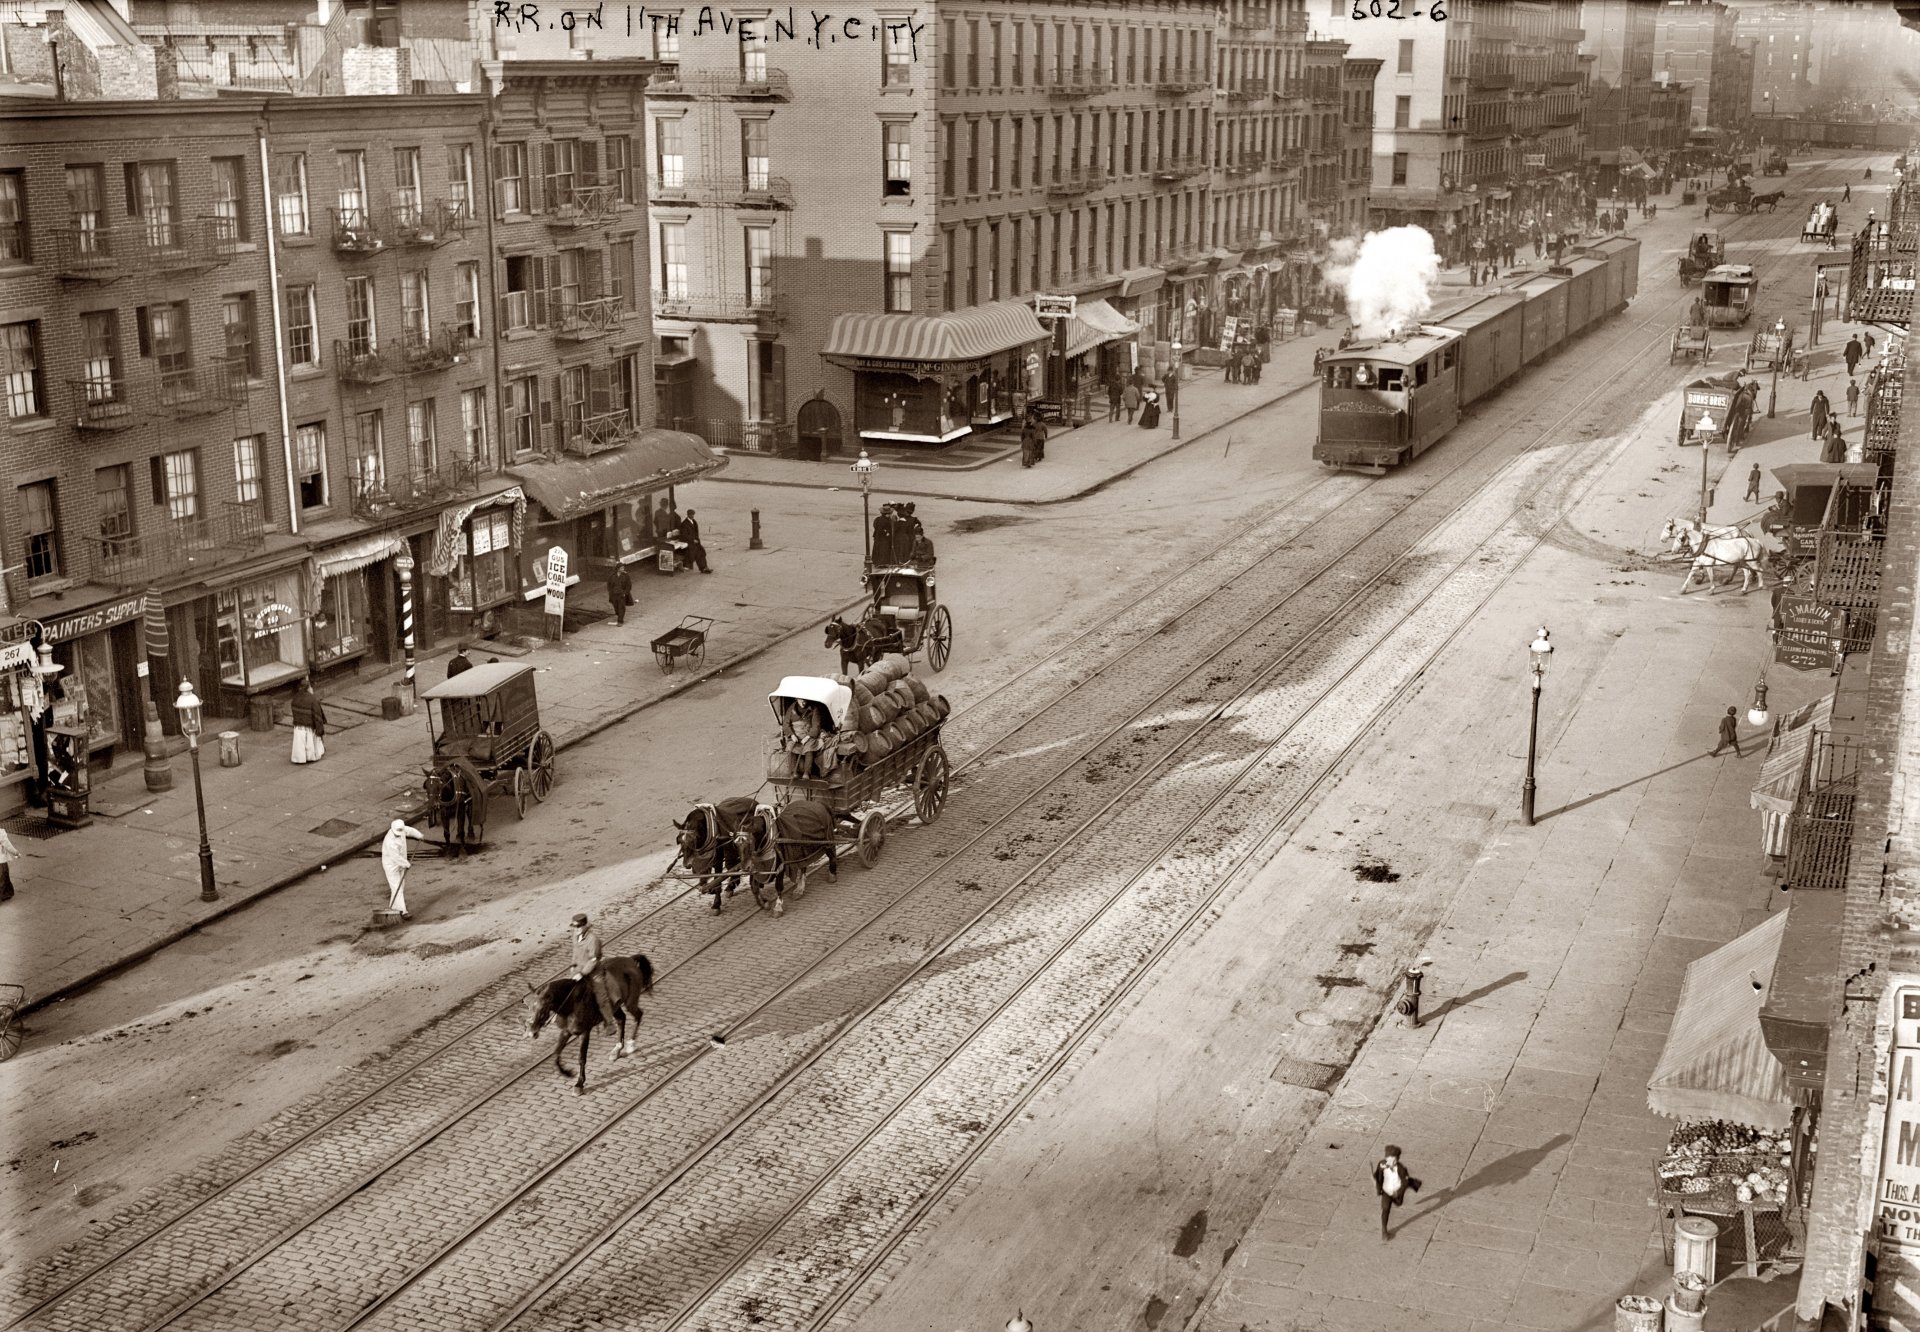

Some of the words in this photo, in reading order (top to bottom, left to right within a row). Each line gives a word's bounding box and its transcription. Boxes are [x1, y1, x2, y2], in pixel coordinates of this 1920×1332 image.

[550, 562, 566, 574] ICE
[548, 572, 566, 584] COAL
[547, 587, 564, 600] WOOD
[43, 611, 104, 641] PAINTERS
[1785, 627, 1828, 645] TAILOR
[4, 647, 21, 661] 267
[1790, 654, 1817, 666] 272
